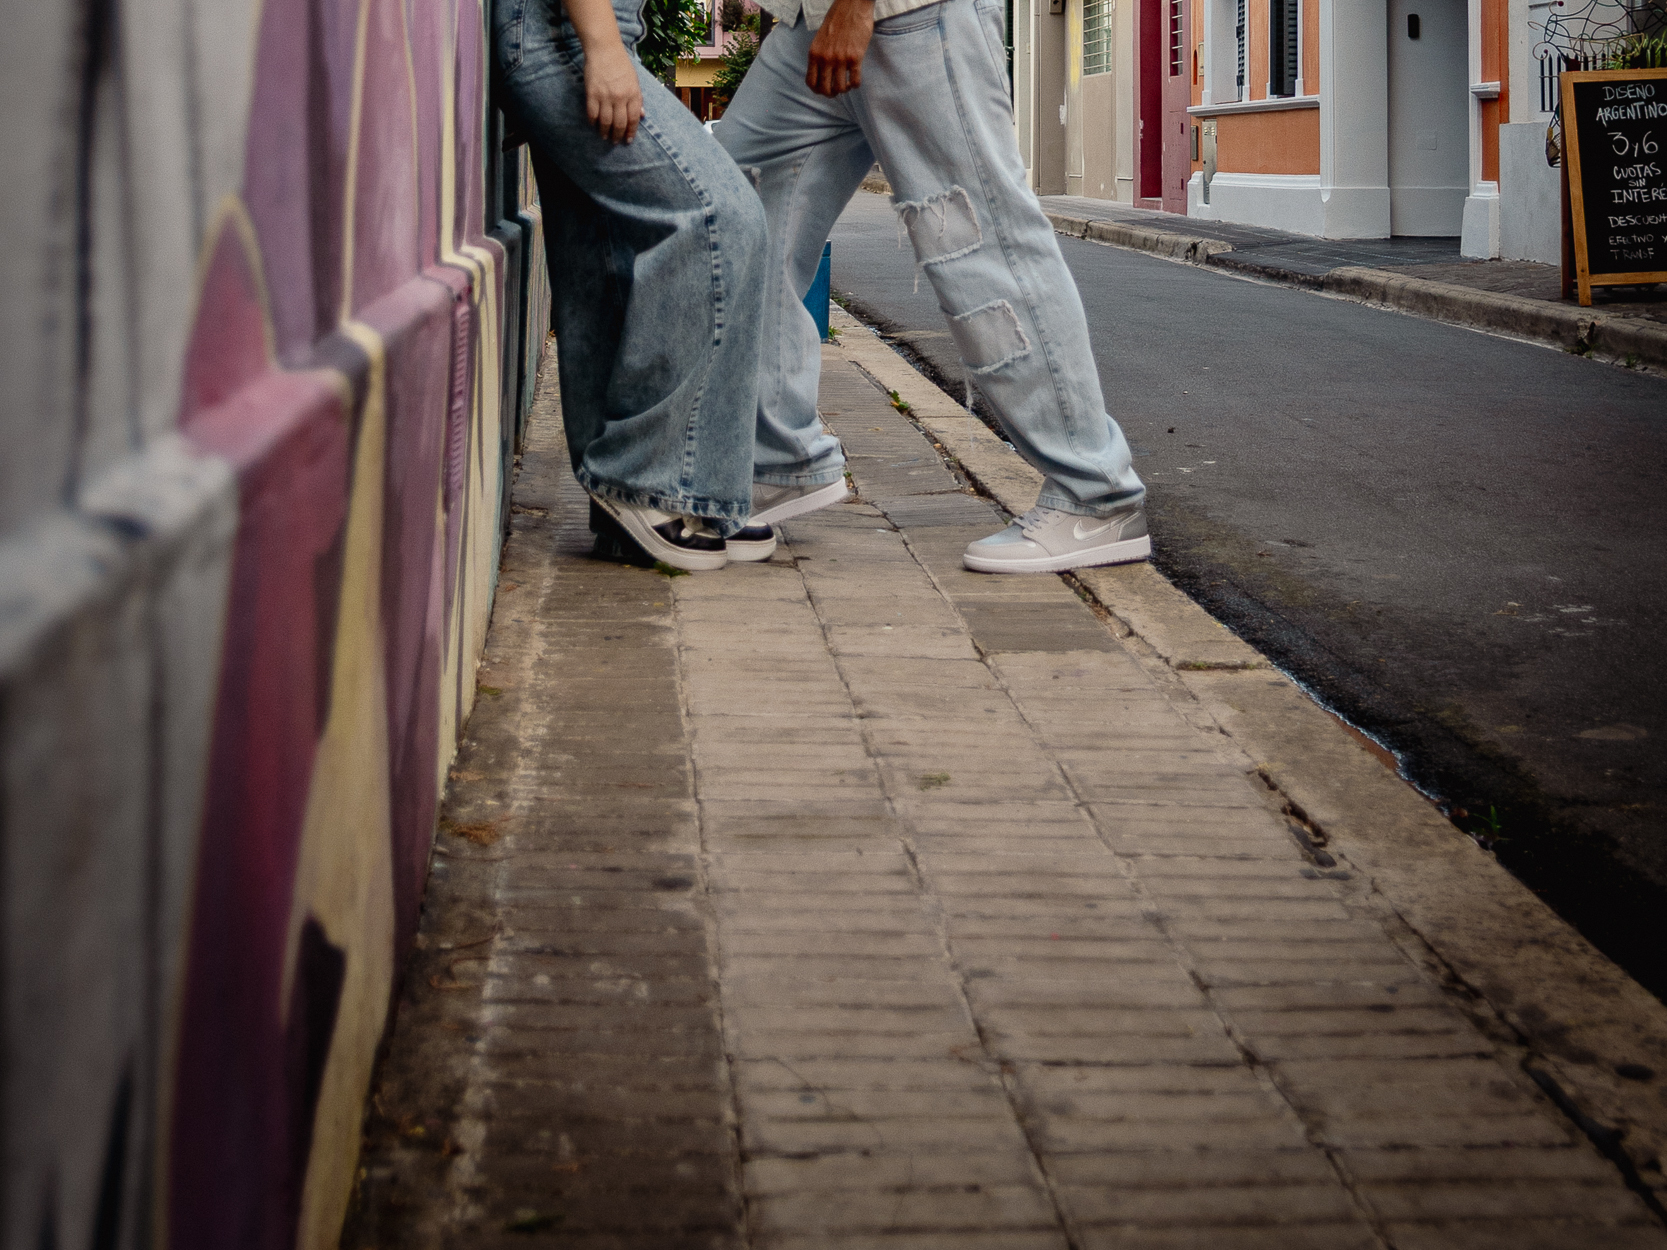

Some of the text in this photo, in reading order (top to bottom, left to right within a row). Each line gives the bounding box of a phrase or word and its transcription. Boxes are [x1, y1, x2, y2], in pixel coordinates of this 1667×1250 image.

[1602, 83, 1655, 100] DISEÑO
[1596, 101, 1667, 128] ARGENTINO
[1607, 131, 1629, 155] 3
[1643, 131, 1658, 154] 6
[1613, 162, 1661, 179] CUOTAS
[1628, 178, 1646, 187] SIN
